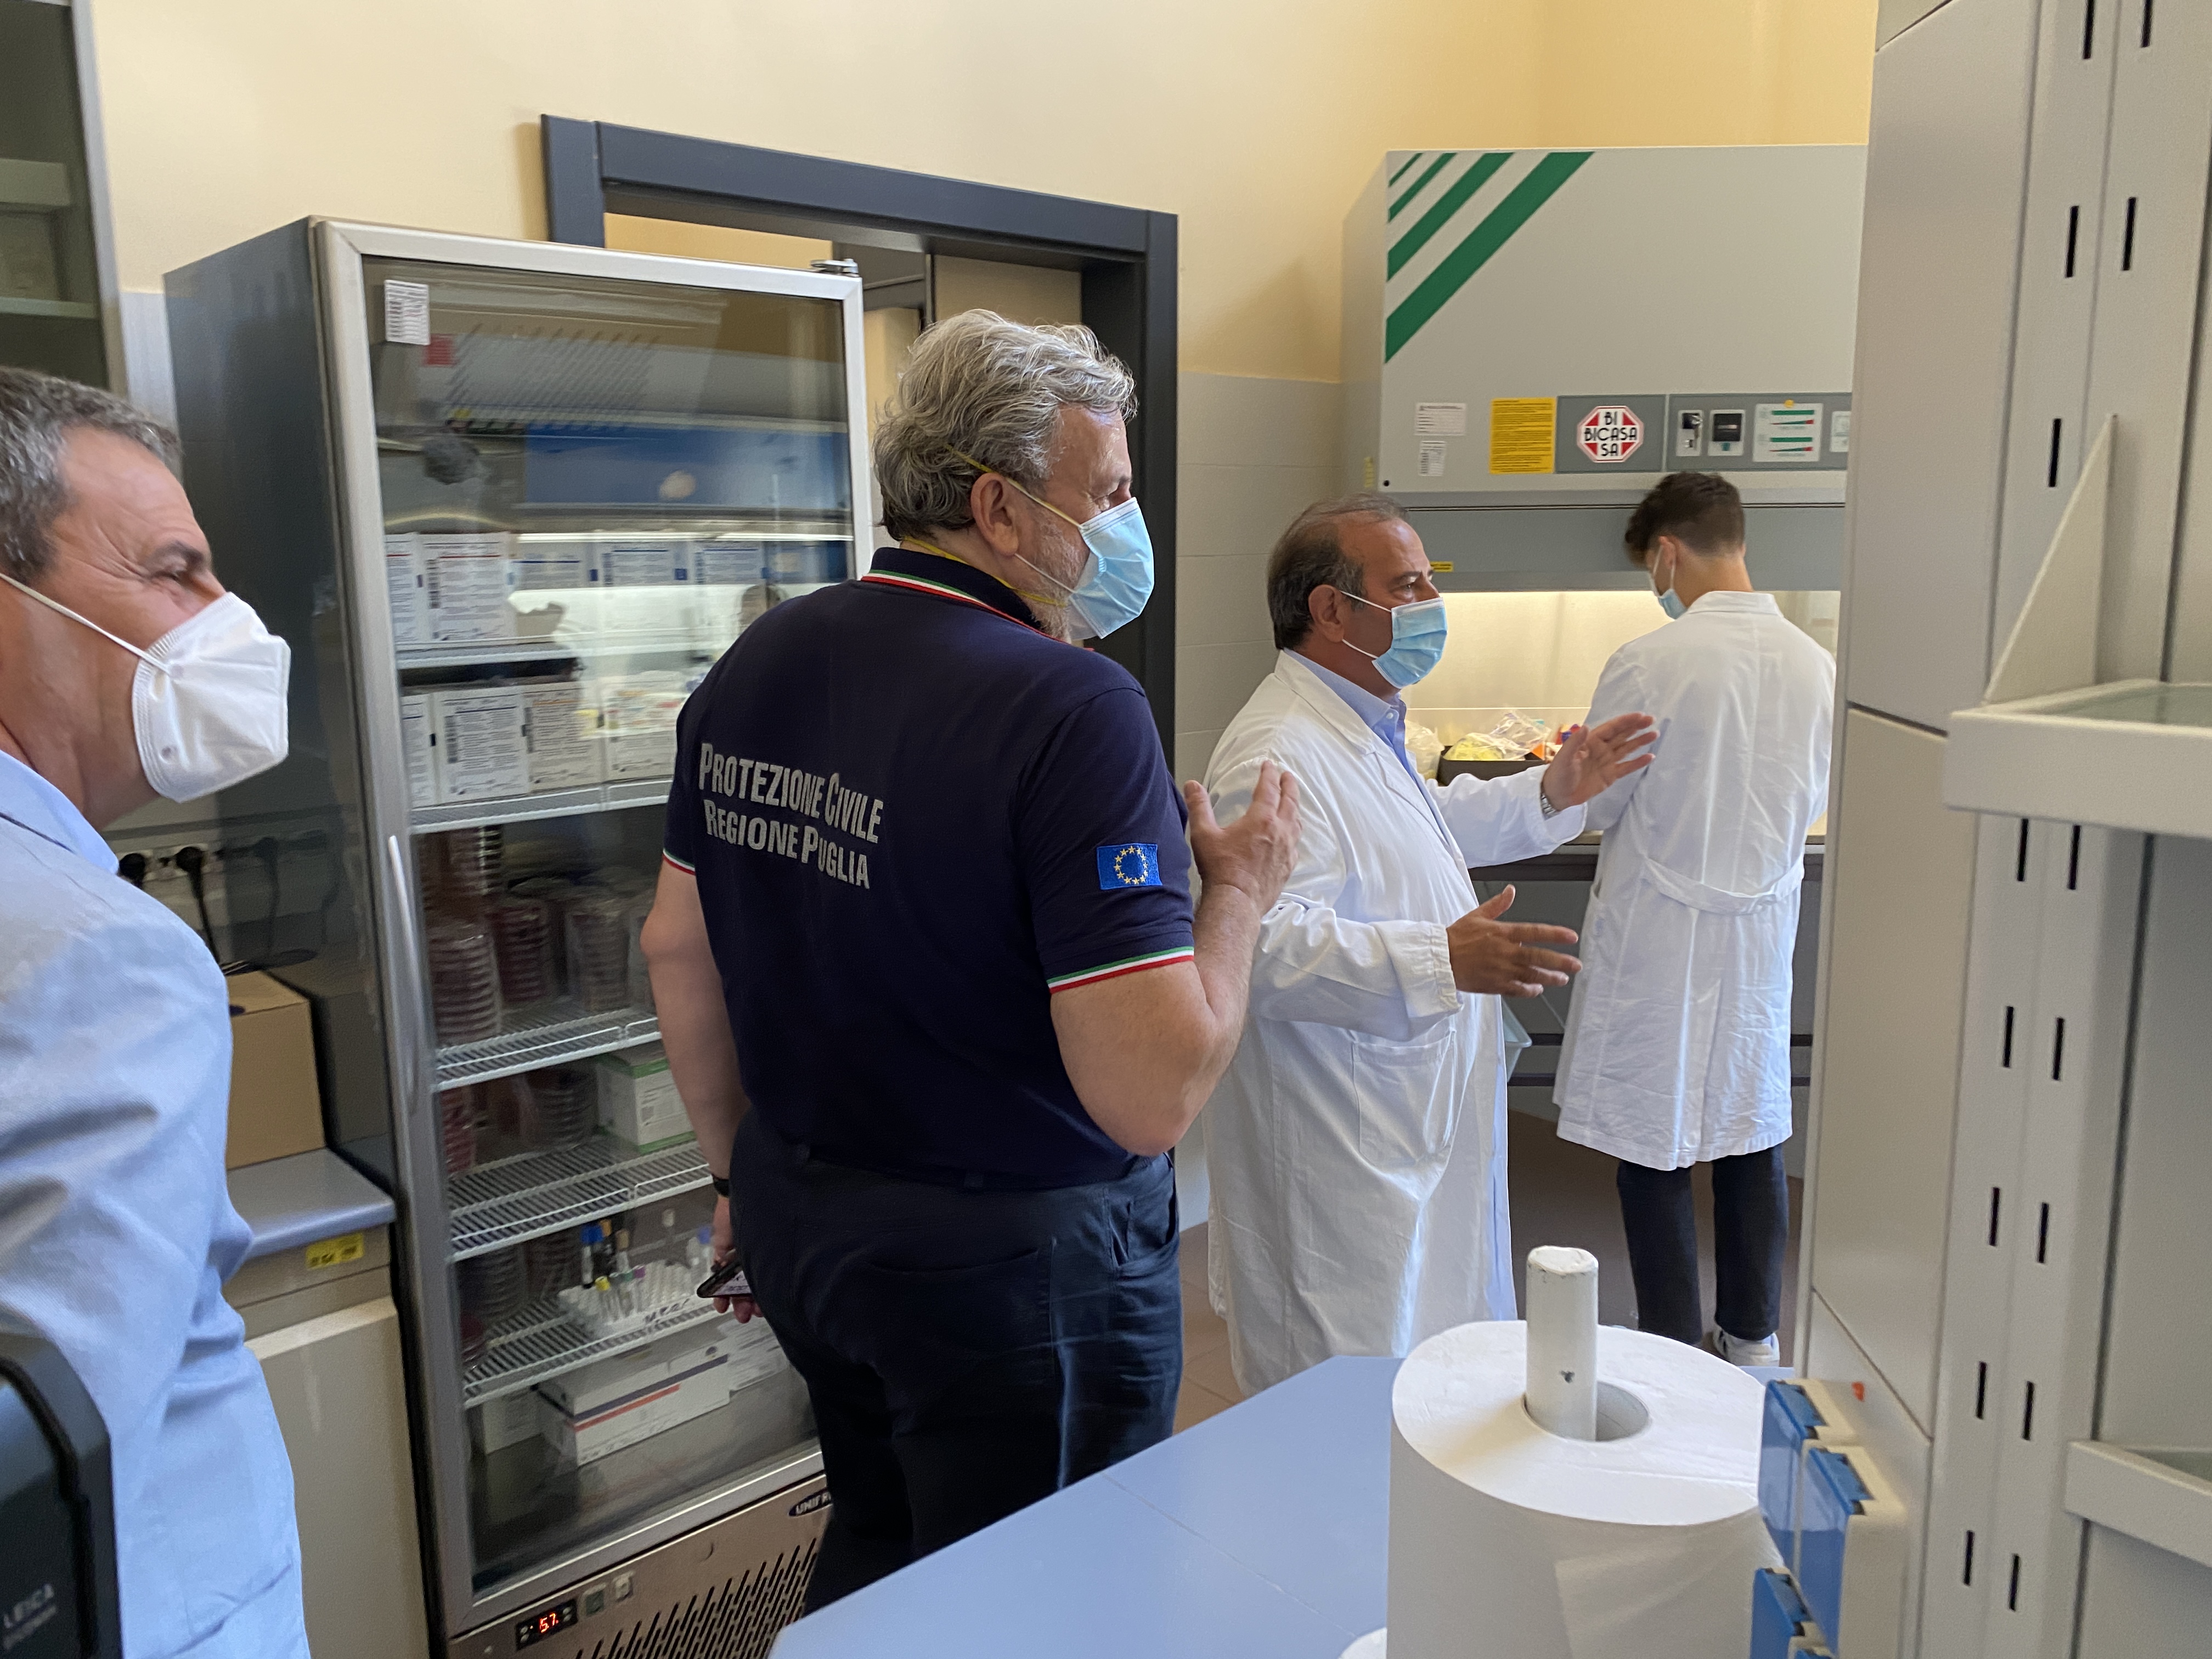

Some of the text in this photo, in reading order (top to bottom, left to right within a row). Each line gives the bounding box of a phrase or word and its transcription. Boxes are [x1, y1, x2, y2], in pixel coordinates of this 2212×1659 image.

[1604, 411, 1618, 425] BI
[1584, 427, 1638, 441] BICASA
[1601, 443, 1618, 456] SA
[698, 742, 884, 844] PROTEZIONE CIVILE
[703, 799, 871, 889] REGIONE PUGLIA
[795, 1492, 832, 1514] UNIFR
